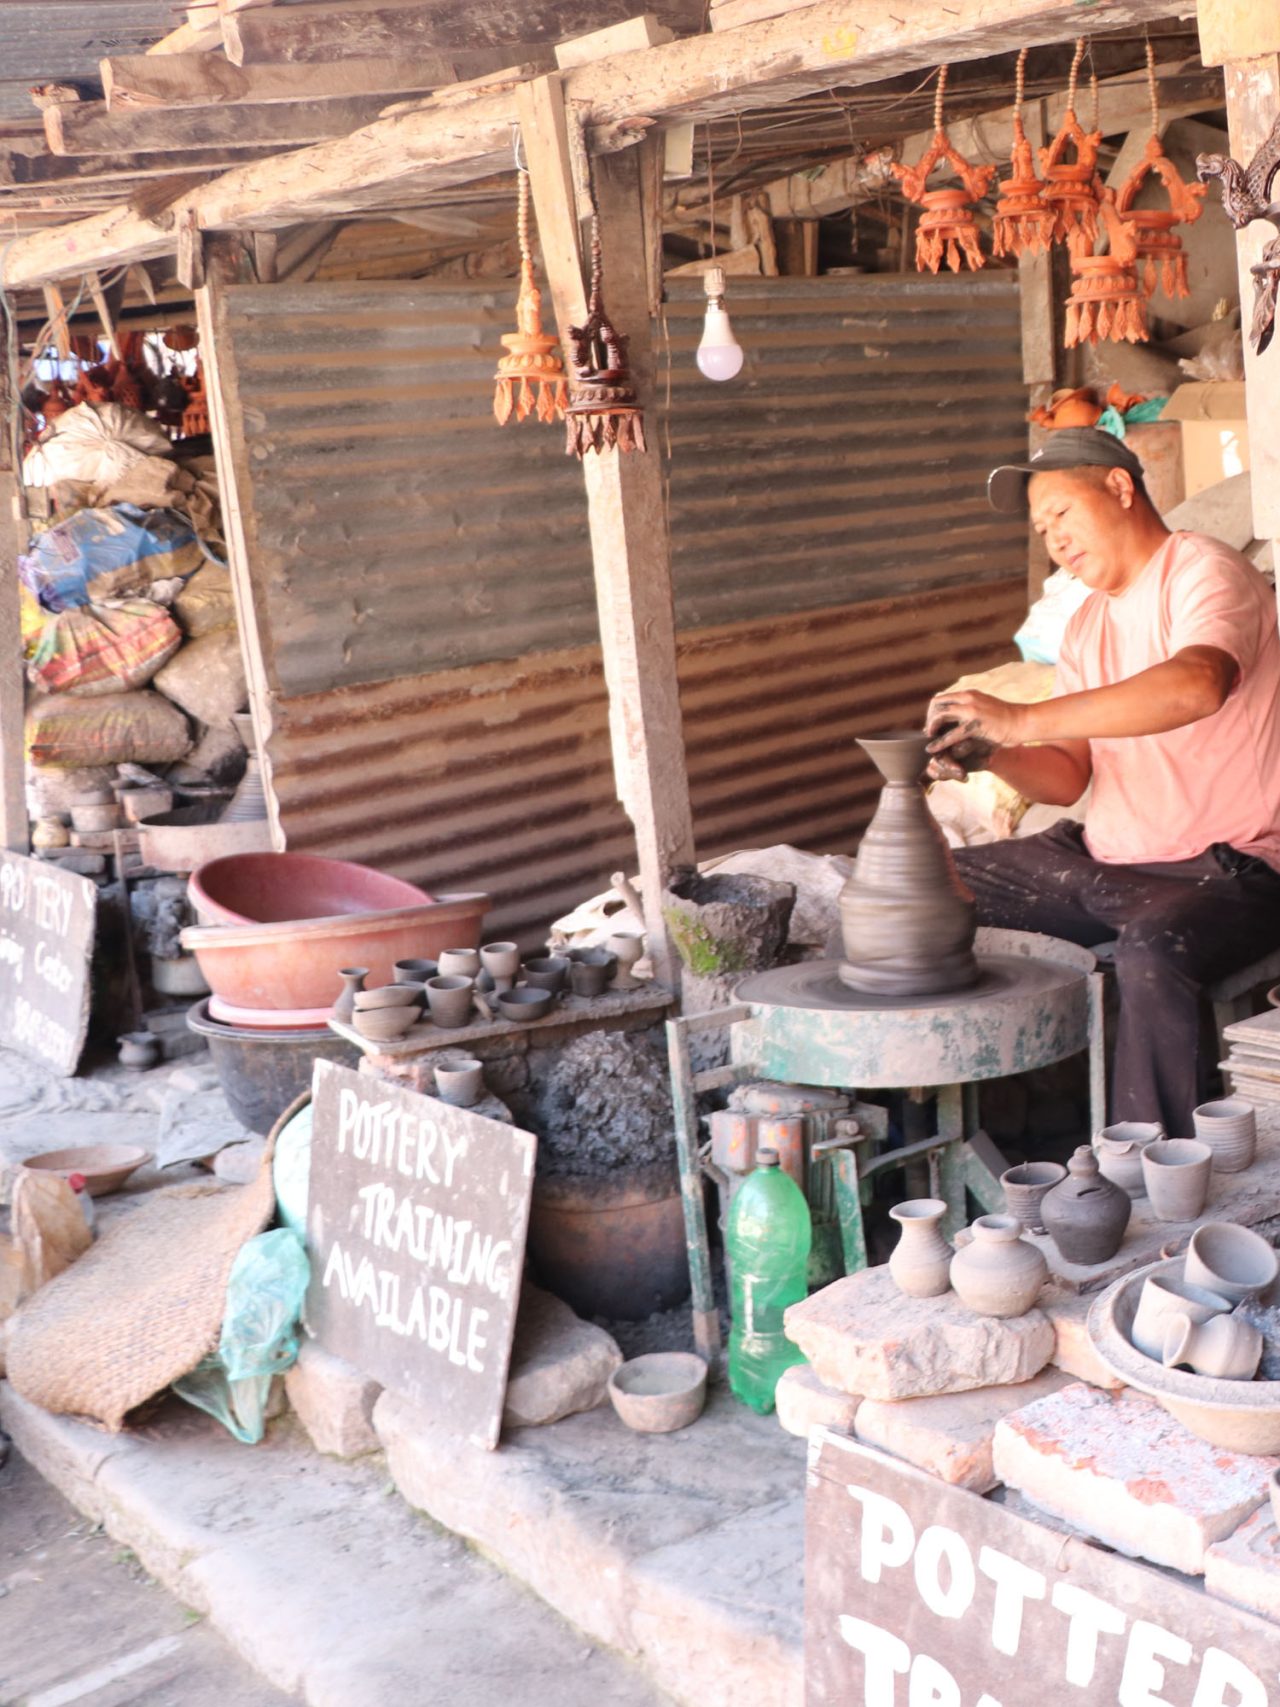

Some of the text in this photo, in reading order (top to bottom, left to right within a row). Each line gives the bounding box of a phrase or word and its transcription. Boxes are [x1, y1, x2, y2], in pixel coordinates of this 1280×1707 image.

[338, 1088, 467, 1187] POTTERY
[358, 1182, 512, 1300] TRAINING
[322, 1241, 490, 1373] AVAILABLE
